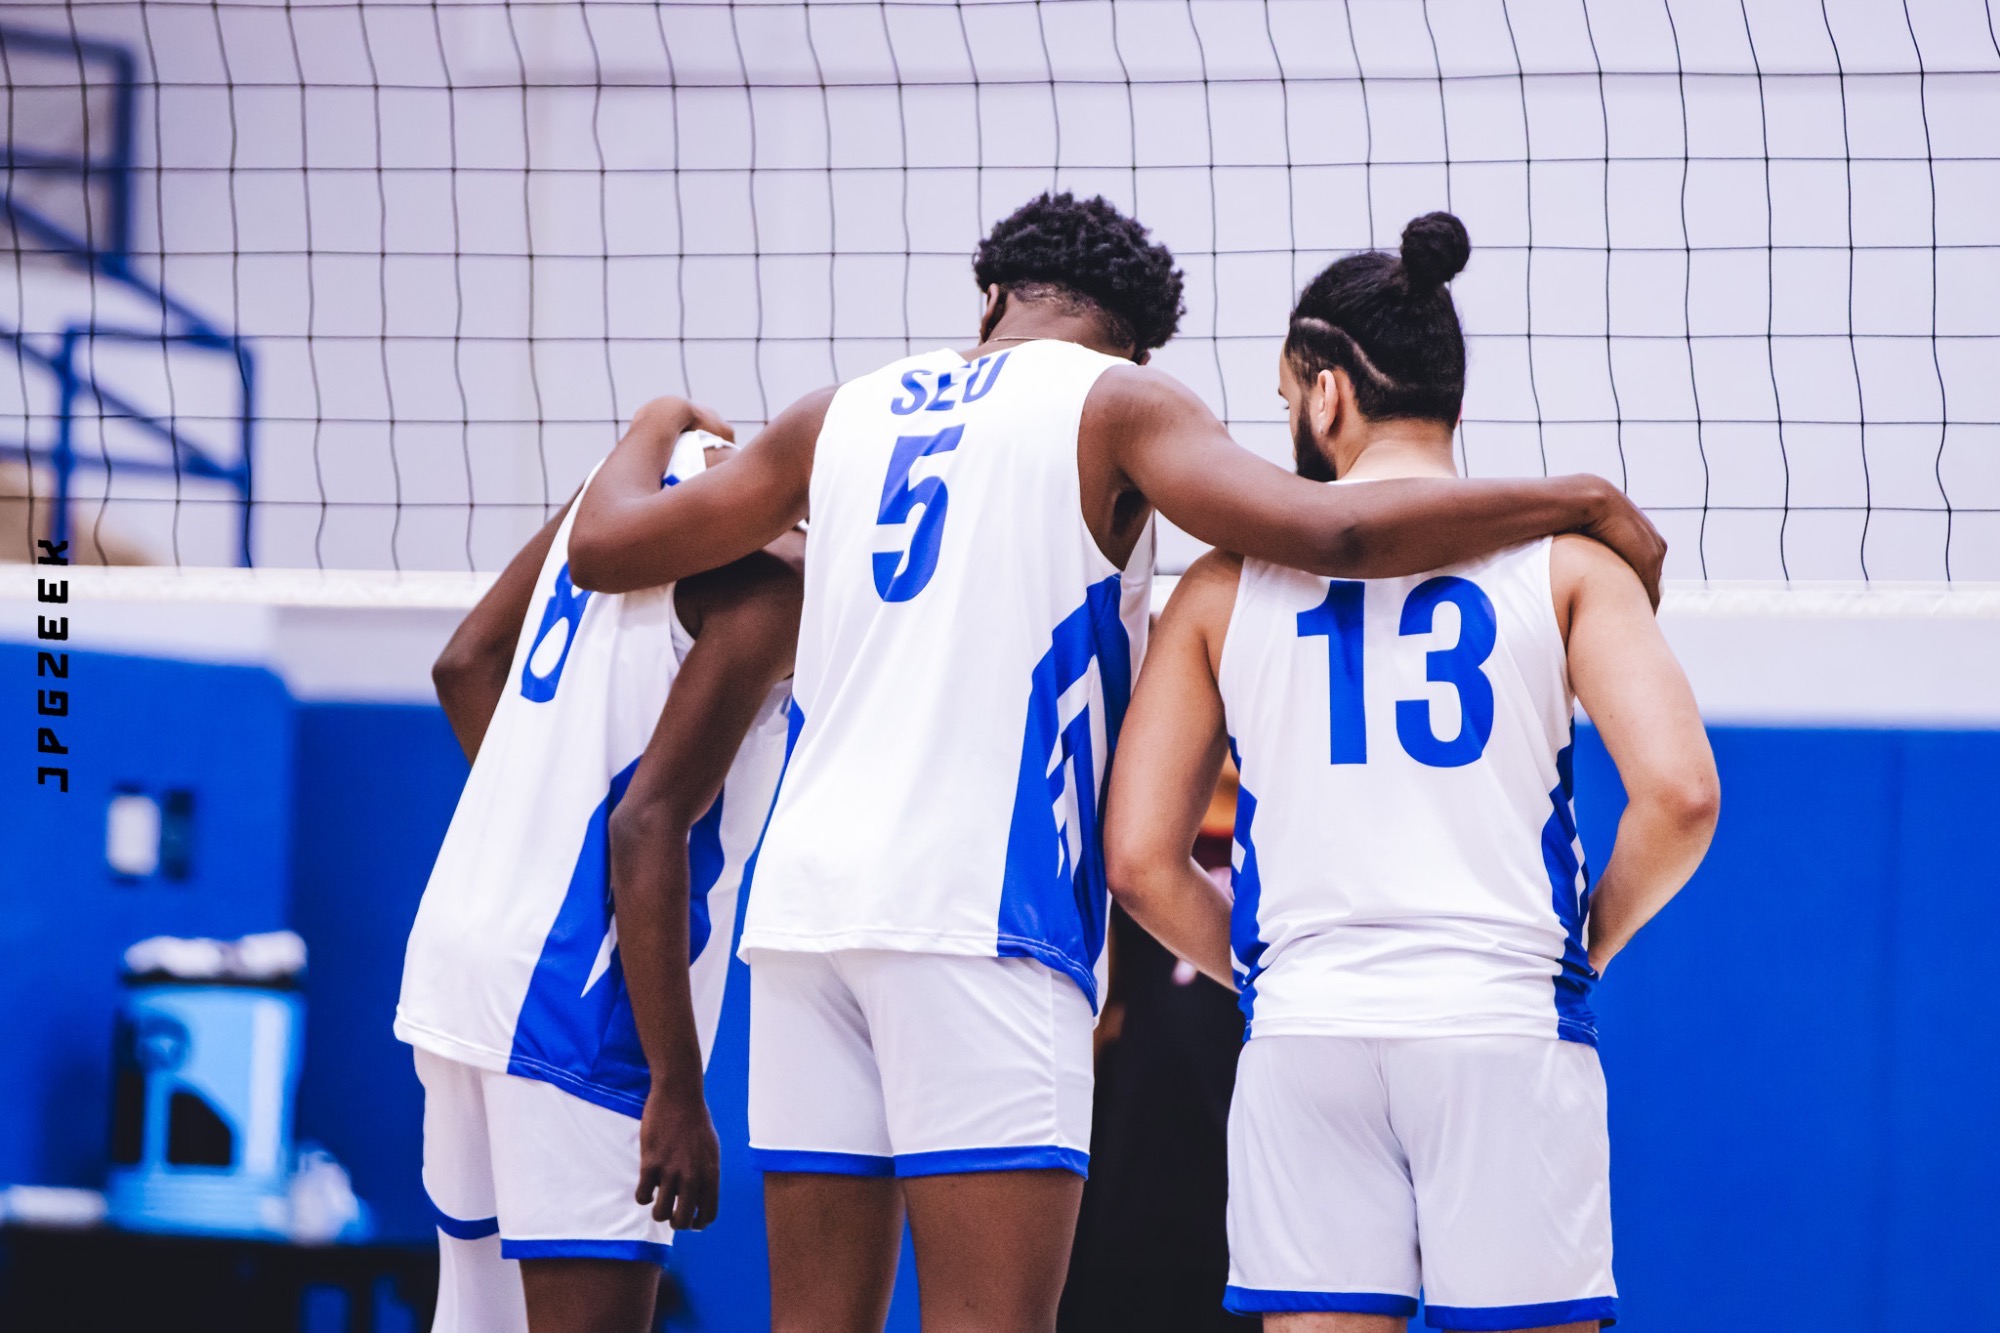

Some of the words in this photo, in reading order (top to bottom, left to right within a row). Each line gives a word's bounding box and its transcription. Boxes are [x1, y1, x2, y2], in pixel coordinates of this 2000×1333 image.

[890, 350, 1012, 415] SEU
[872, 423, 966, 603] 5
[520, 560, 594, 703] 8
[1296, 575, 1497, 768] 13
